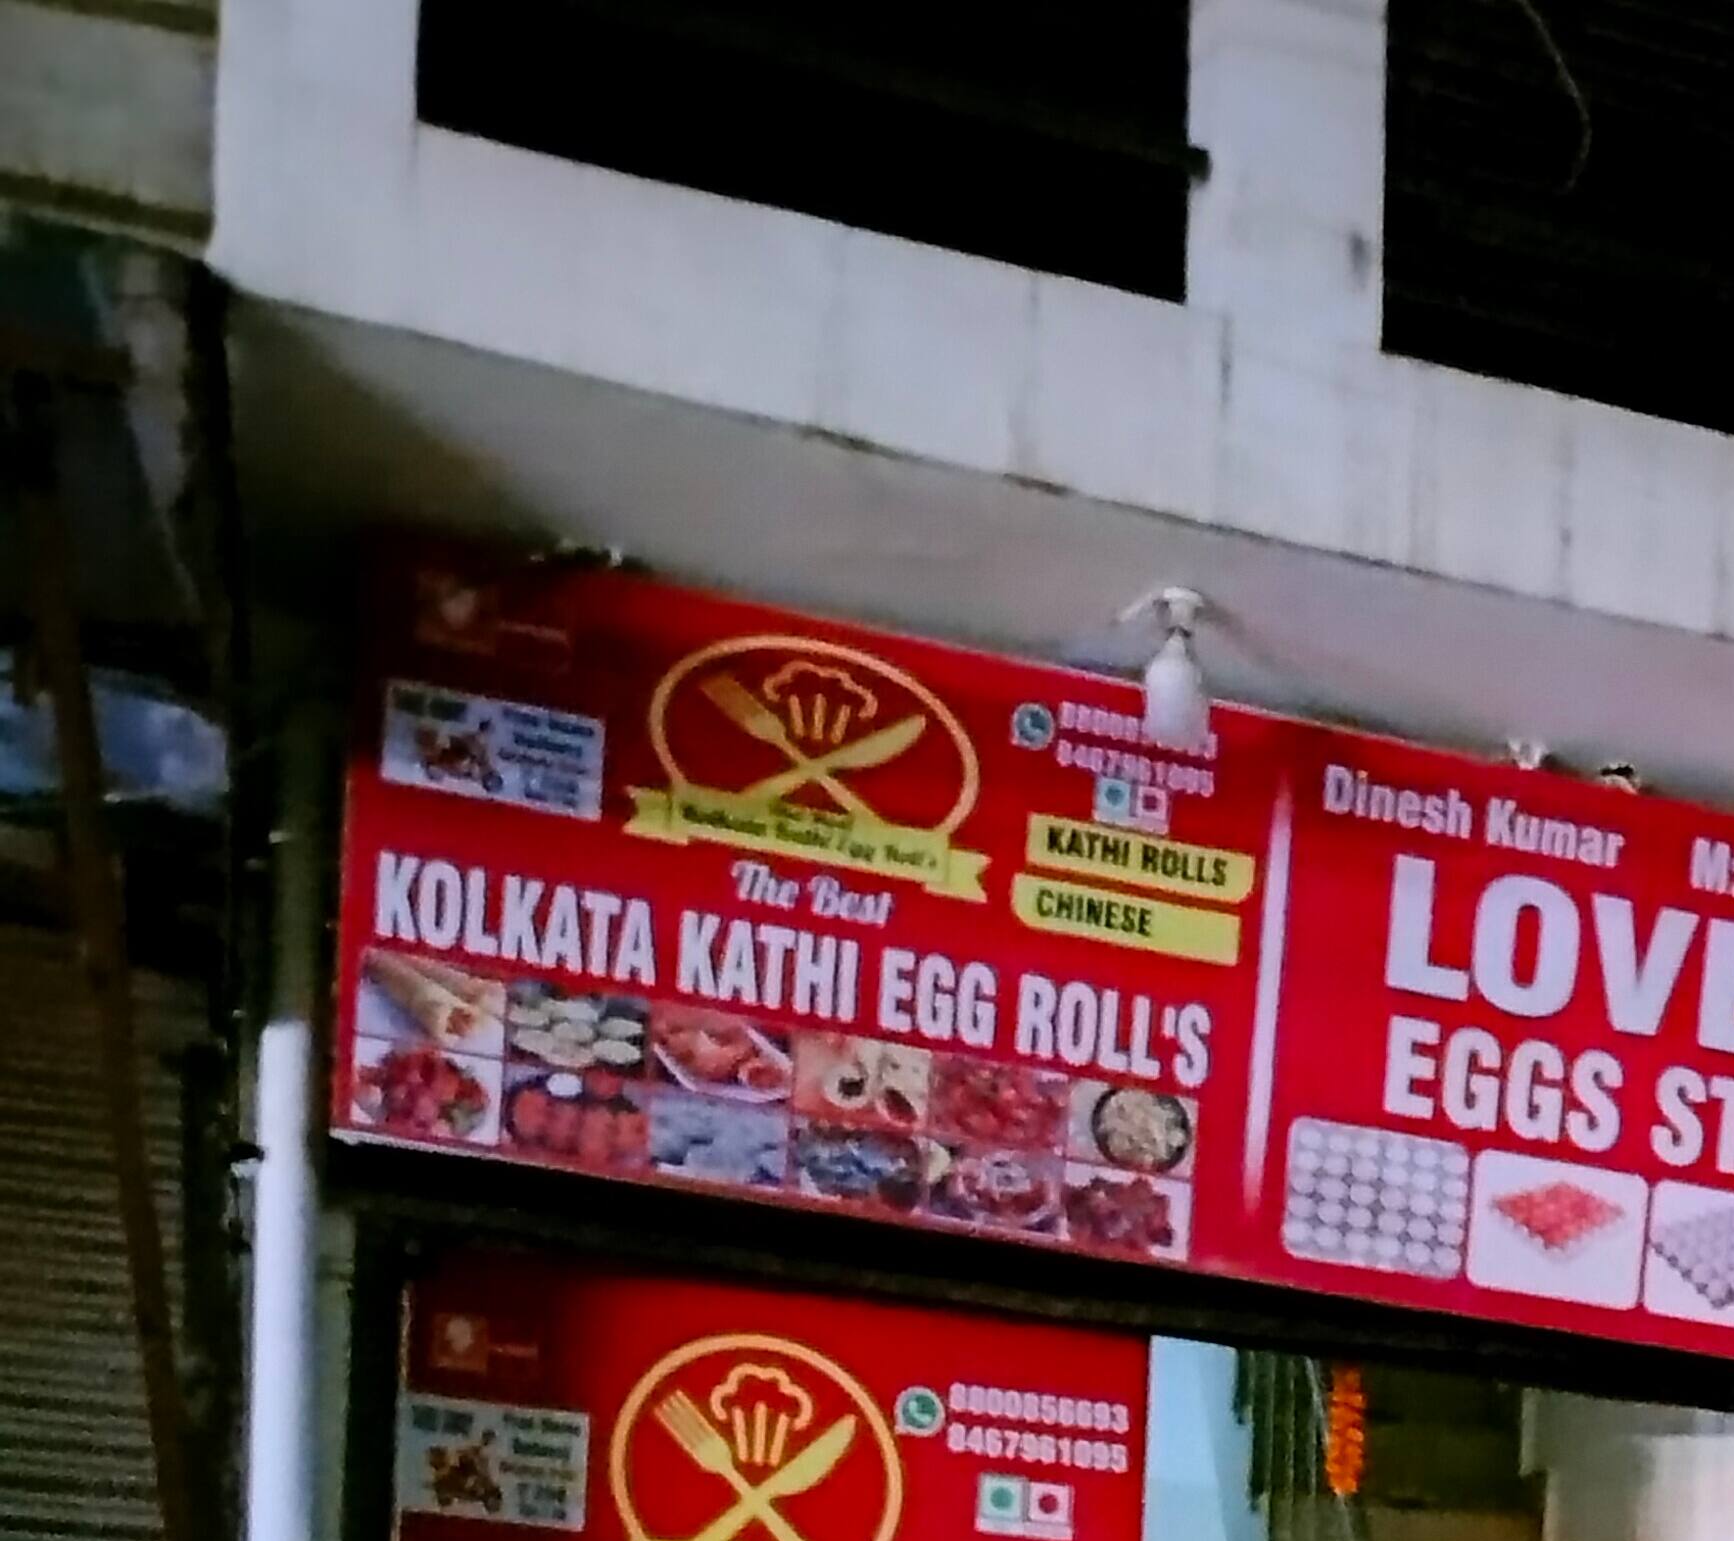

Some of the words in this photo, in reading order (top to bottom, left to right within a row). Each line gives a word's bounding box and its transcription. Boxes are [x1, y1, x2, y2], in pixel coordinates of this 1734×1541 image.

[1047, 824, 1130, 867] KATHI
[1141, 842, 1228, 887] ROLLS
[1323, 764, 1471, 839] Dinesh
[1486, 801, 1624, 869] Kumar
[731, 860, 799, 910] The
[808, 875, 894, 929] Best
[1036, 887, 1153, 937] CHINESE
[373, 851, 656, 987] KOLKATA
[677, 910, 858, 1023] KATHI
[877, 947, 998, 1049] EGG
[1016, 973, 1213, 1087] ROLL'S
[1383, 1015, 1624, 1154] EGGS
